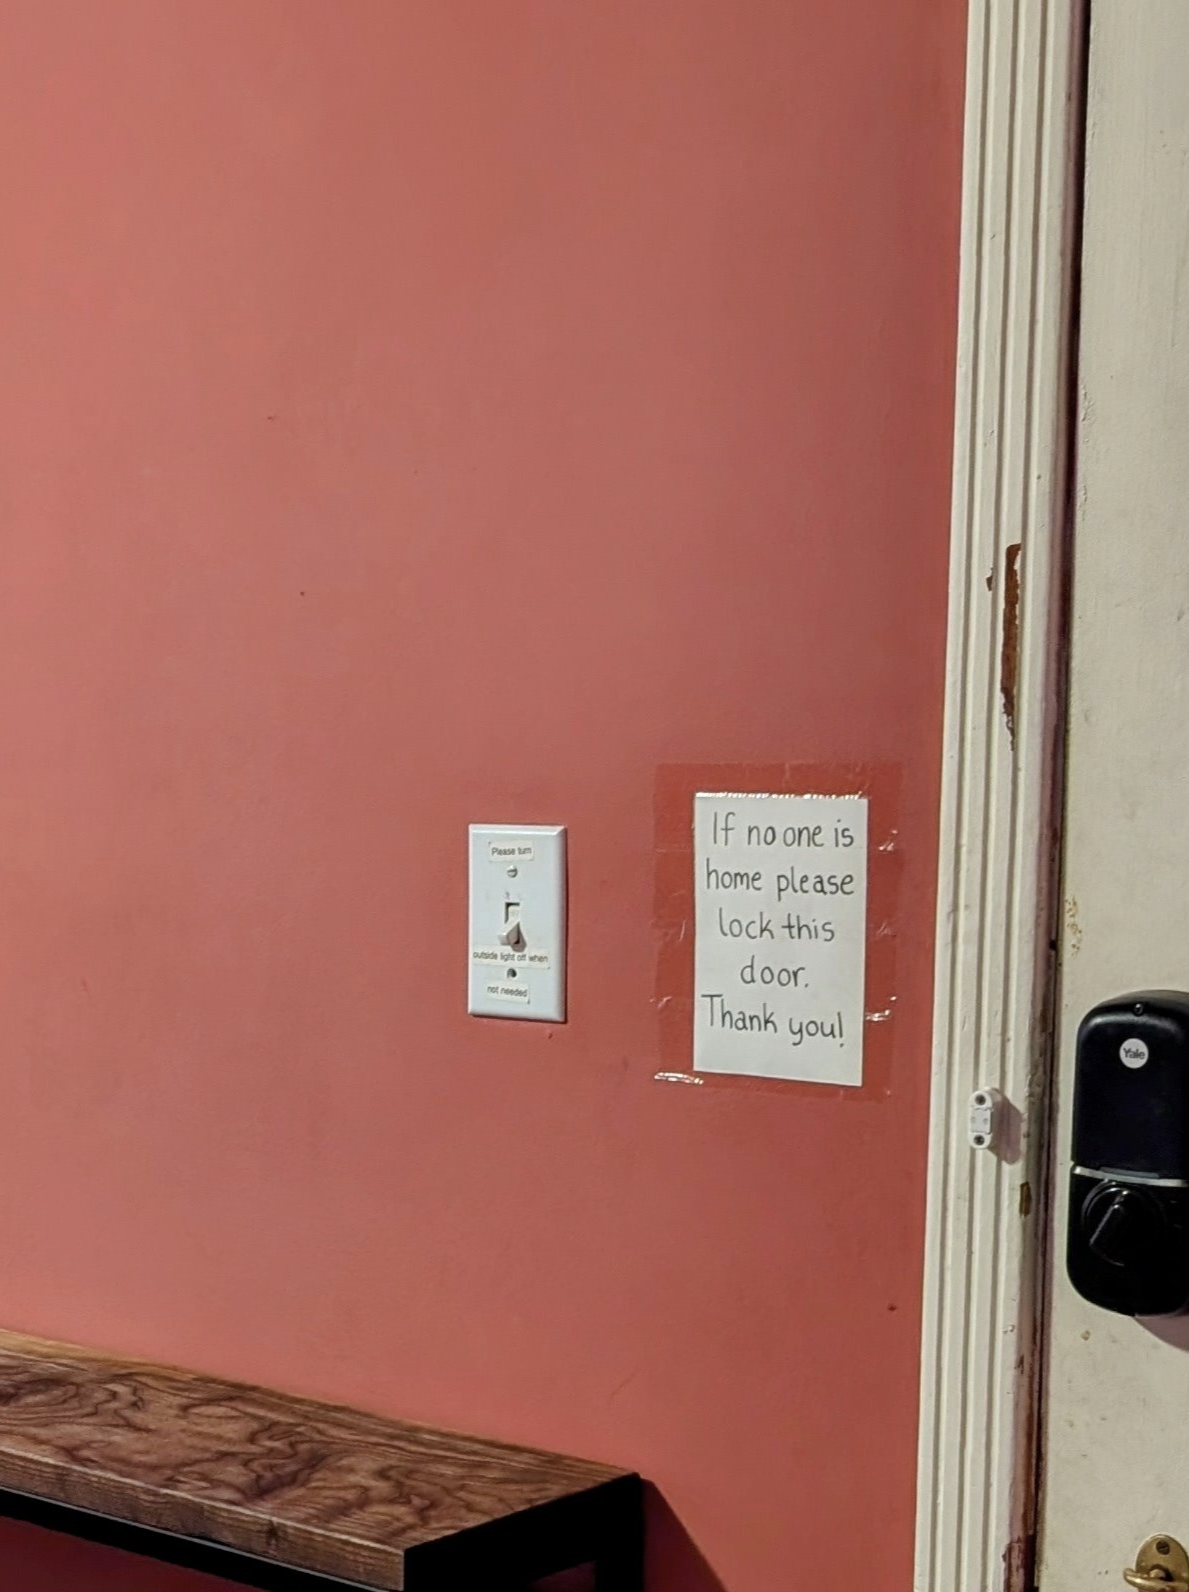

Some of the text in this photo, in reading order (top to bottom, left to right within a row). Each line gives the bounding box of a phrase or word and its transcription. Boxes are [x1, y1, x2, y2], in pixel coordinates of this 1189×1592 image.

[712, 811, 736, 846] If
[834, 819, 855, 848] is
[491, 846, 532, 856] Please turn
[706, 857, 855, 902] home please
[719, 907, 835, 942] lock this
[472, 951, 549, 963] outside light off when
[740, 954, 809, 989] door.
[487, 985, 528, 997] not needed
[701, 993, 845, 1048] Thank you!
[1123, 1047, 1146, 1060] Yale
